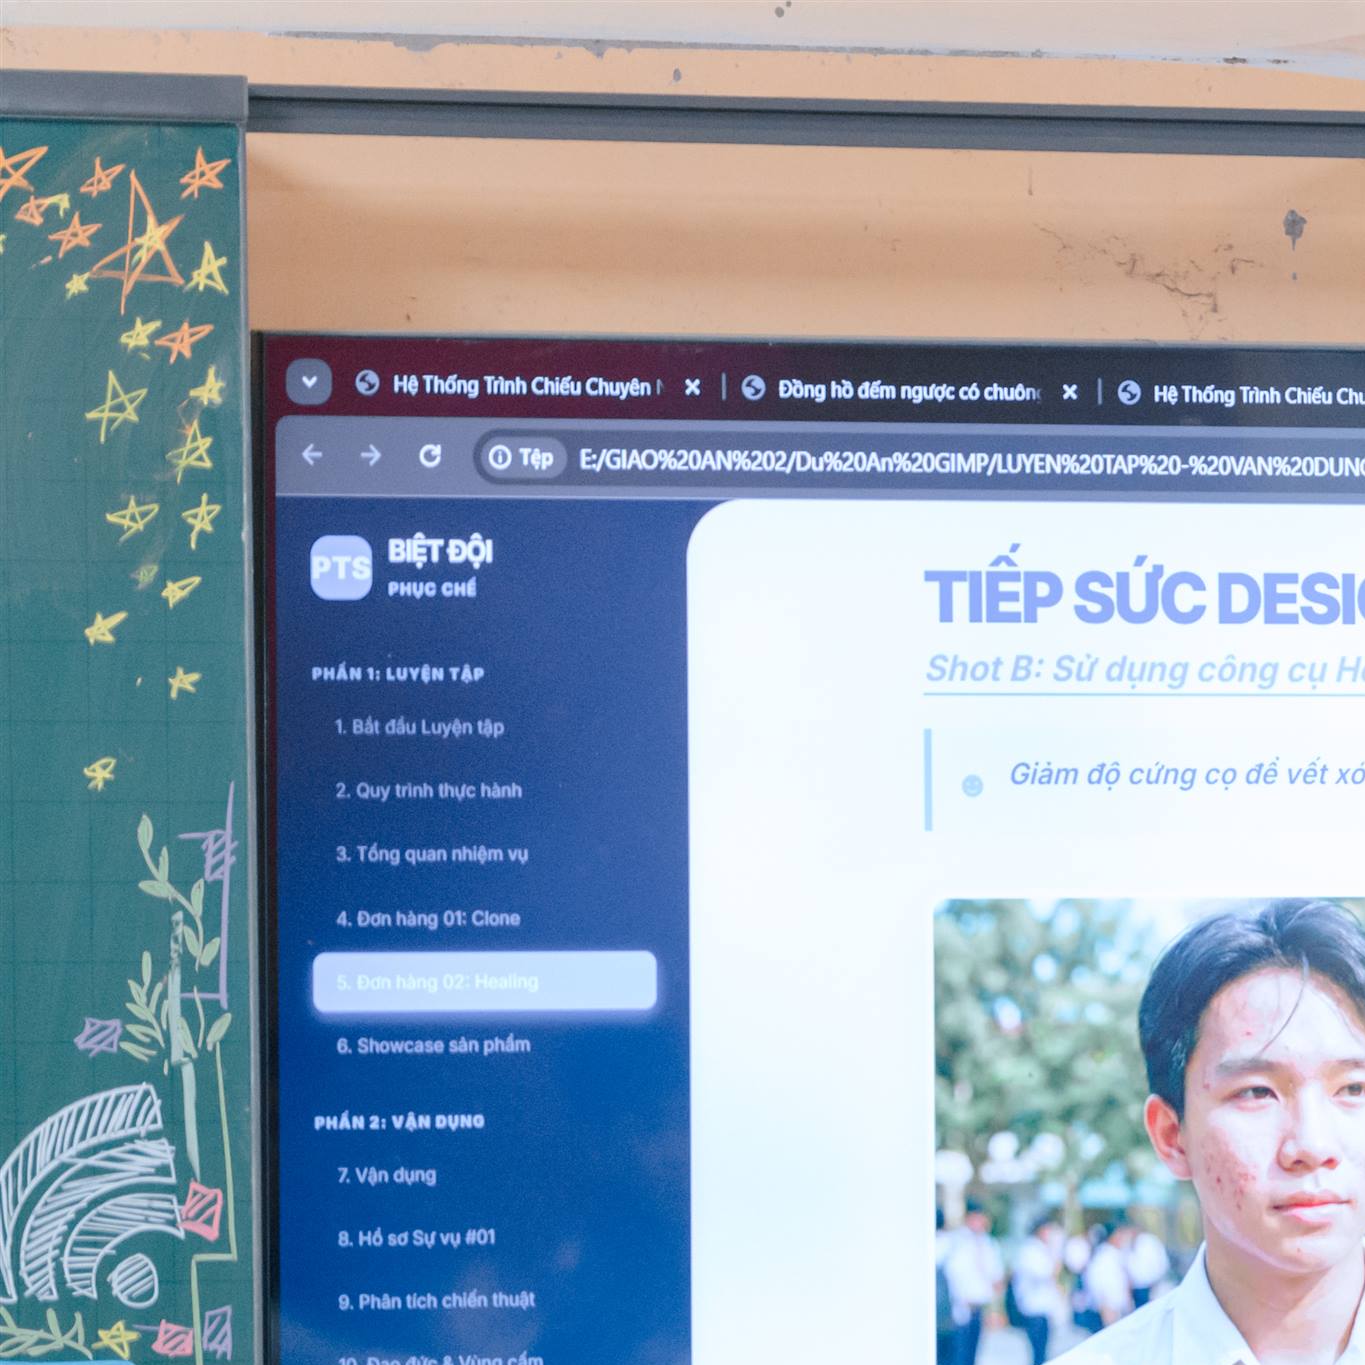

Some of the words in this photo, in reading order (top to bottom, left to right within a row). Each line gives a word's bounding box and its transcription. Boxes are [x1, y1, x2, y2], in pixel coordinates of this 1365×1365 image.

[393, 374, 419, 396] Hệ
[422, 375, 479, 398] Thống
[483, 375, 527, 396] Trình
[531, 376, 582, 396] Chiếu
[585, 378, 651, 400] Chuyên
[778, 378, 826, 402] Đồng
[830, 380, 854, 400] hồ
[857, 380, 896, 400] đếm
[900, 383, 955, 403] ngược
[959, 382, 980, 400] có
[519, 447, 554, 471] Tệp
[388, 532, 444, 569] BIỆT
[446, 532, 493, 569] ĐỘI
[312, 555, 372, 580] PTS
[388, 581, 436, 599] PHỤC
[924, 543, 1064, 624] TIẾP
[1073, 555, 1207, 626] SỨC
[367, 667, 380, 681] 1:
[386, 664, 444, 683] LUYỆN
[449, 664, 485, 683] TẬP
[925, 654, 1002, 684] Shot
[1010, 656, 1045, 684] B:
[1052, 651, 1098, 684] Sử
[1105, 655, 1189, 691] dụng
[1197, 655, 1280, 692] công
[1287, 661, 1327, 691] cụ
[1010, 760, 1078, 786] Giảm
[1086, 762, 1121, 791] độ
[1129, 758, 1197, 791] cứng
[1204, 766, 1238, 791] cọ
[1245, 756, 1280, 787] để
[1287, 756, 1328, 787] vết
[336, 911, 352, 927] 4.
[357, 911, 391, 927] Đơn
[443, 911, 467, 927] 01:
[471, 910, 521, 927] Clone
[337, 1037, 352, 1053] 6.
[357, 1036, 444, 1053] Showcase
[338, 1167, 350, 1184] 7.
[356, 1166, 388, 1186] Vận
[393, 1166, 437, 1187] dụng
[338, 1231, 353, 1247] 8.
[388, 1231, 409, 1246] sơ
[413, 1229, 436, 1248] Sự
[440, 1233, 461, 1248] vụ
[465, 1228, 496, 1245] #01
